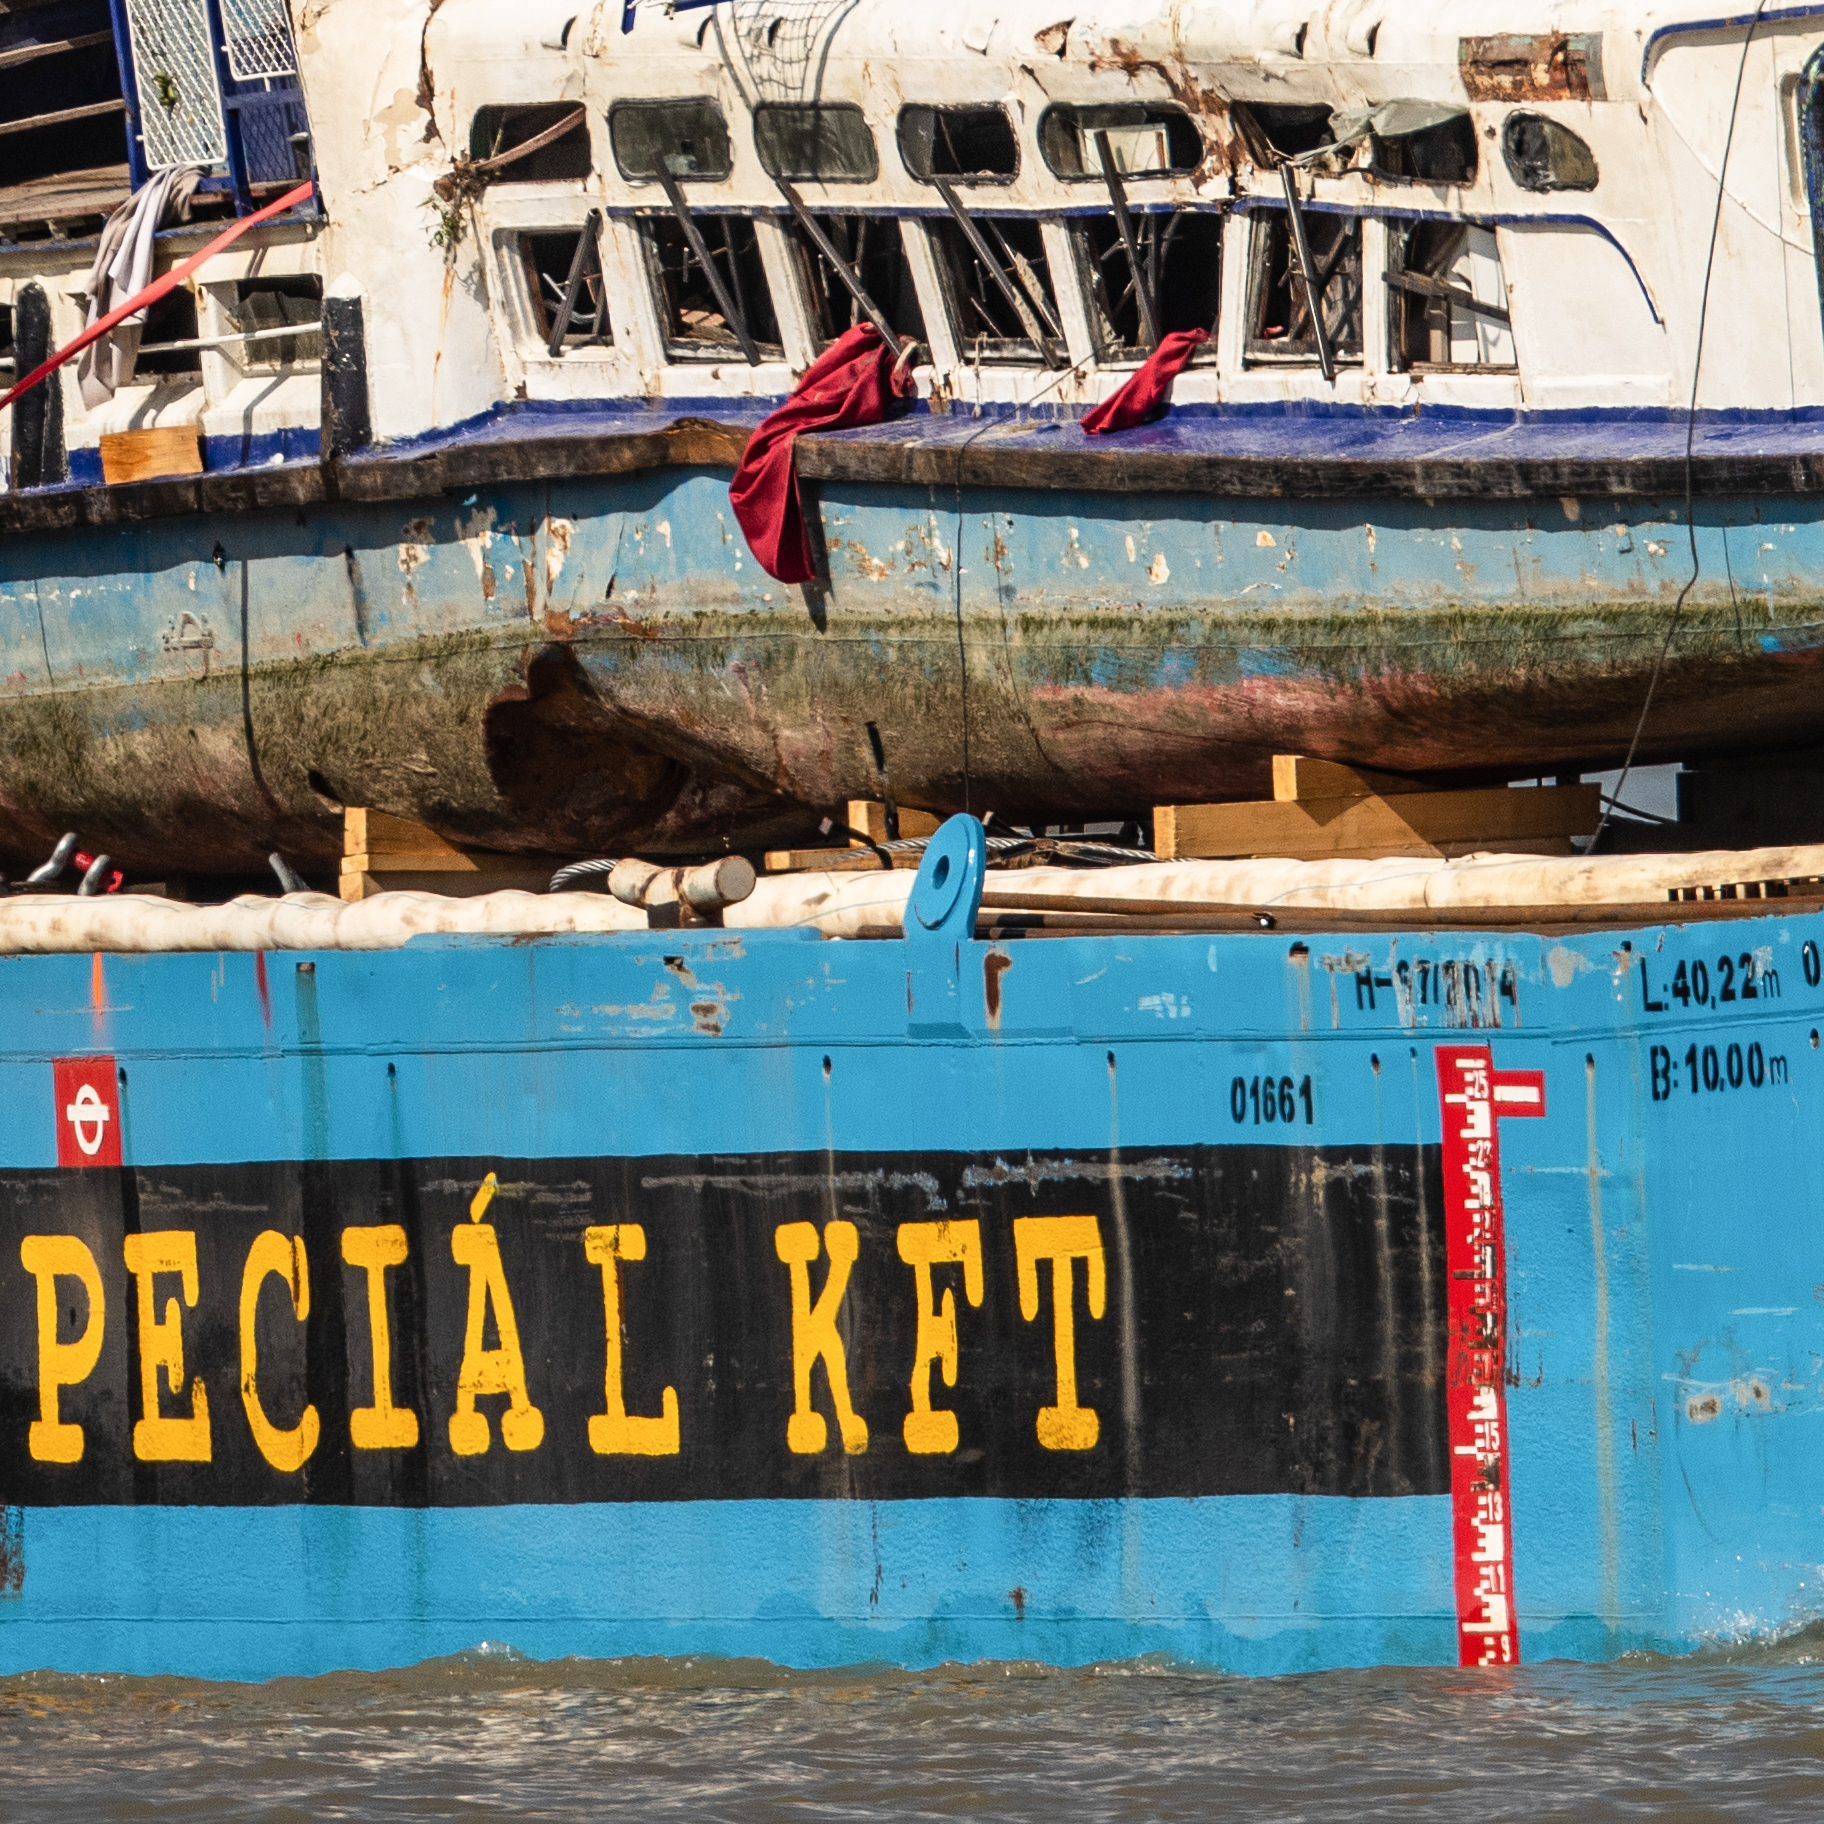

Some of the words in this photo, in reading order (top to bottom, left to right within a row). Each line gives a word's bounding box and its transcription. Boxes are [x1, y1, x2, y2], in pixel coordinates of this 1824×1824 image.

[1230, 1074, 1314, 1125] 01661
[1474, 1069, 1489, 1099] 25
[773, 1214, 1108, 1456] KFT
[1484, 1420, 1500, 1451] 15
[1488, 1491, 1503, 1522] 13
